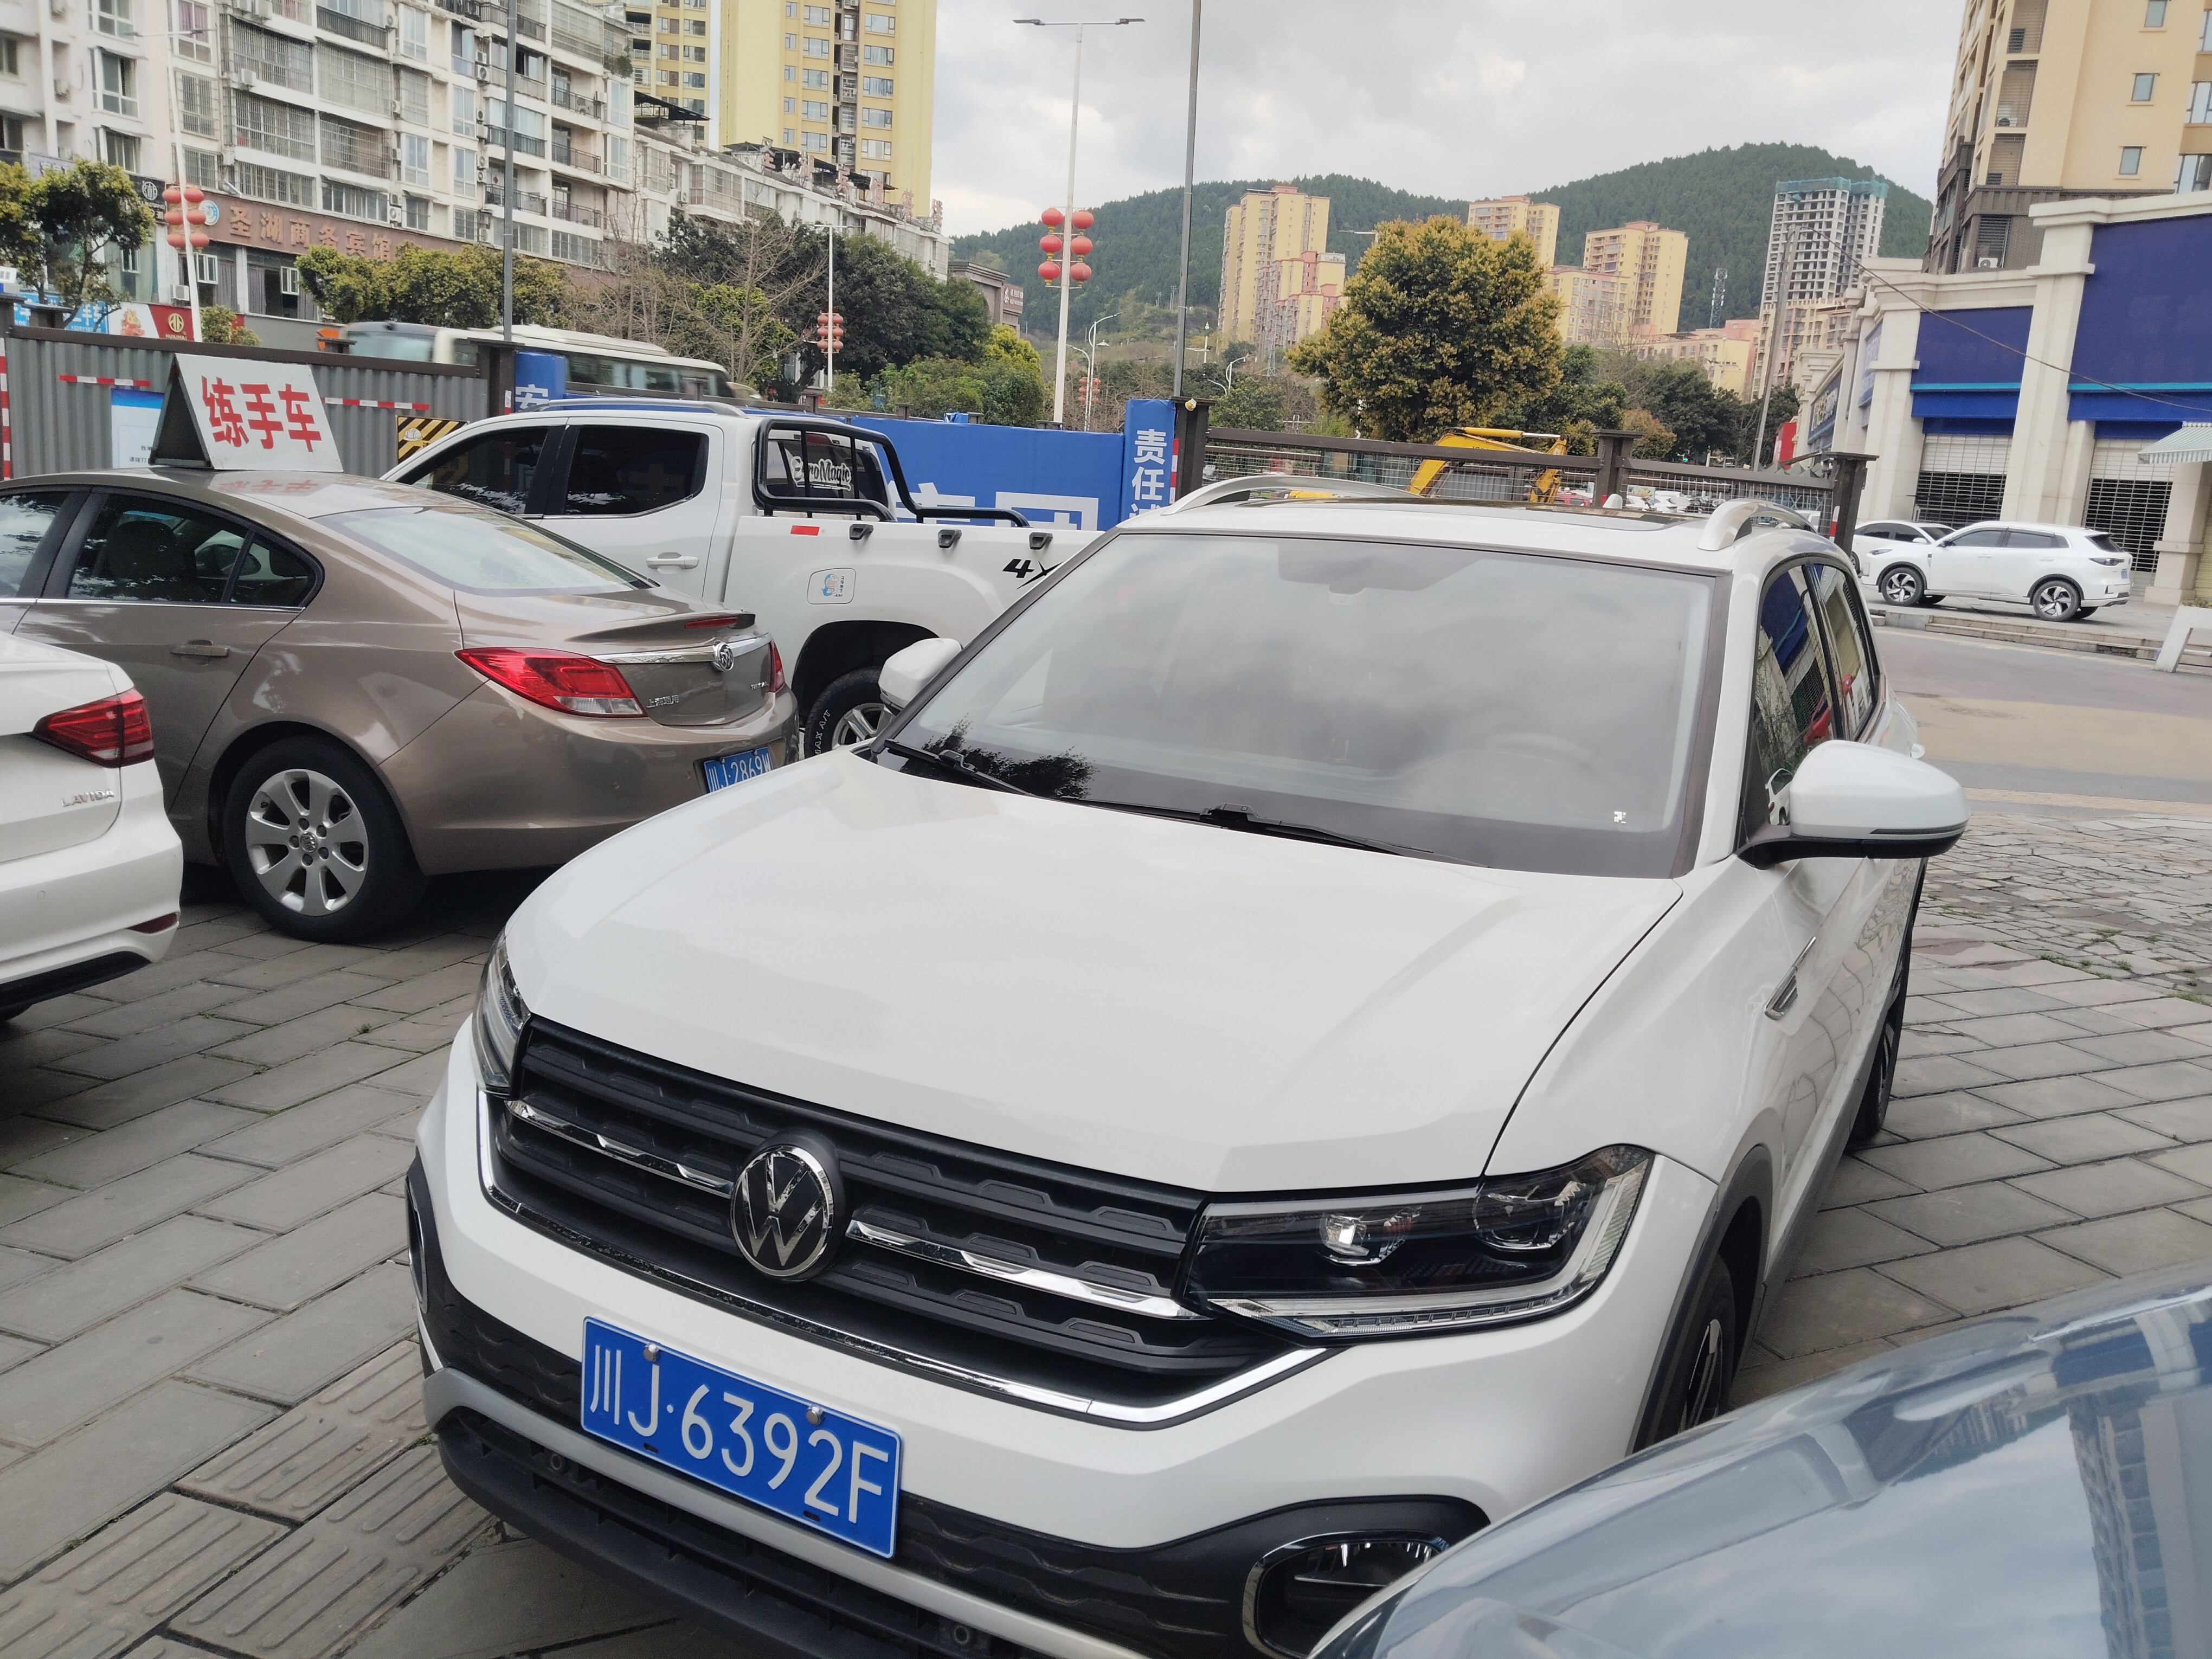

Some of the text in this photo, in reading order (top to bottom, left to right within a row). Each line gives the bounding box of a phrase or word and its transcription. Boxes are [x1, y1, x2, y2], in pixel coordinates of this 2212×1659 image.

[229, 205, 392, 261] 圣湖商务宾馆
[201, 375, 322, 453] 练手车
[792, 456, 851, 489] EroMagic
[60, 789, 114, 807] LAVIDA
[589, 1344, 889, 1525] 川J·6392F
